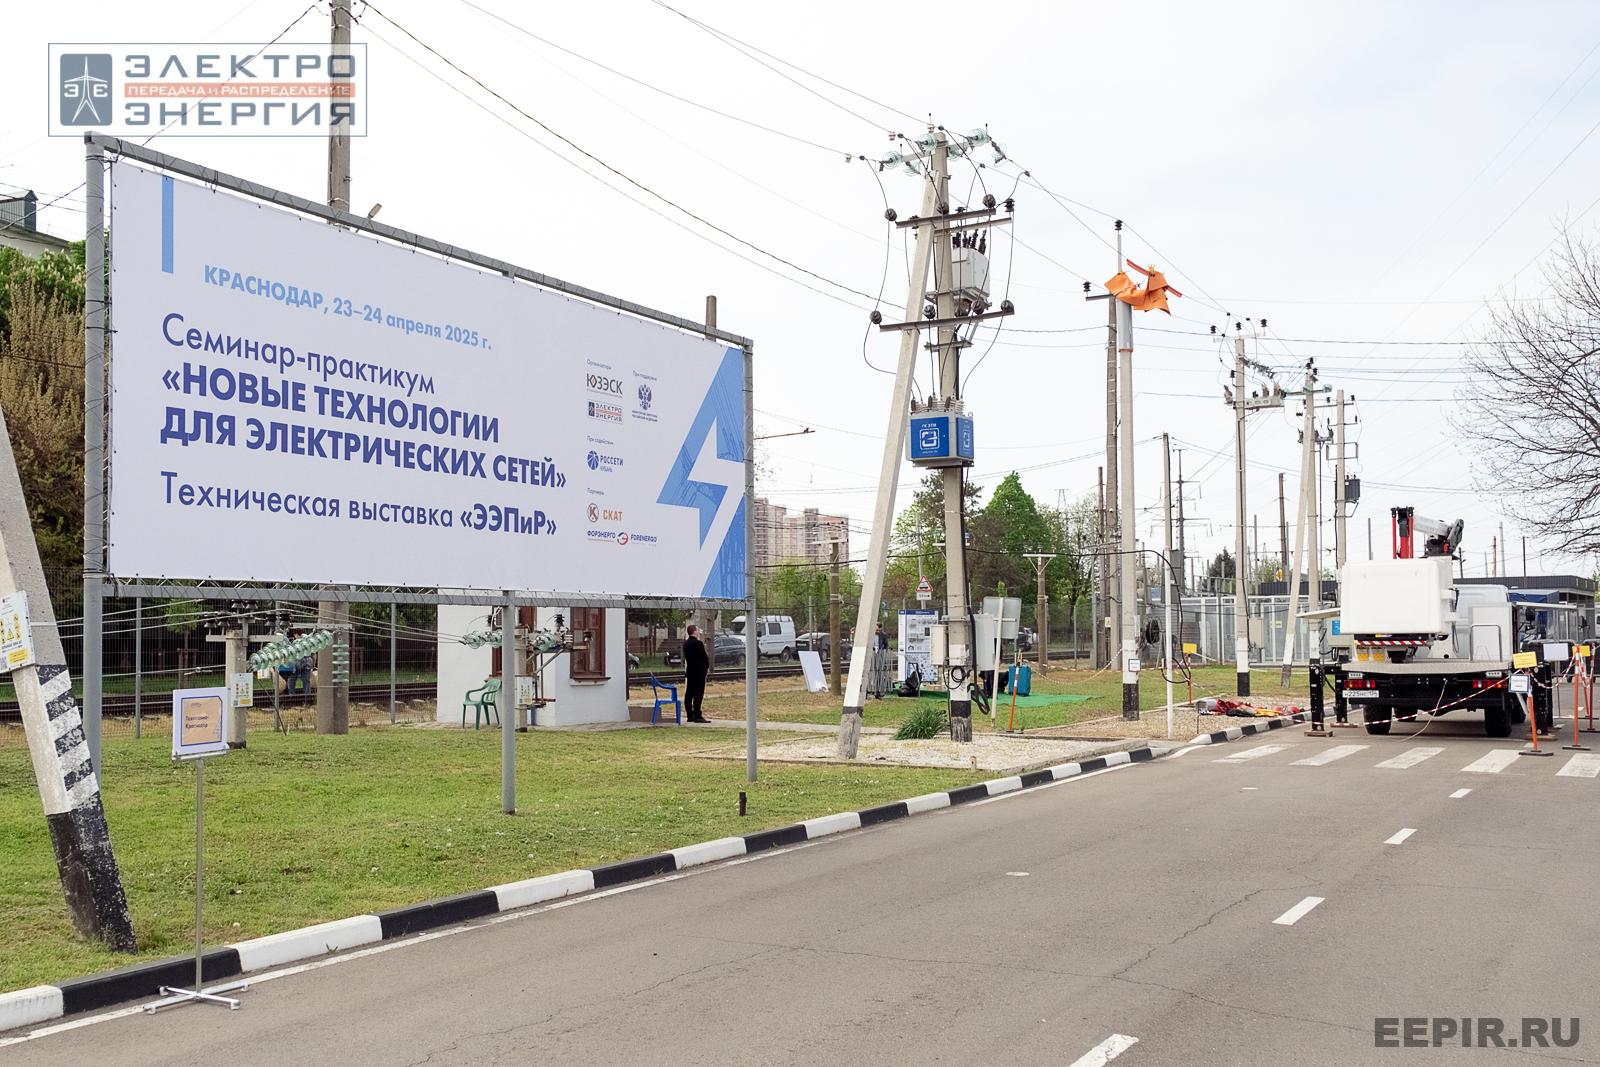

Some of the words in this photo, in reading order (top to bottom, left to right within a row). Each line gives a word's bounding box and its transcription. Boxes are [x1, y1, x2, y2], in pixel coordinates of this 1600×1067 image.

[204, 264, 329, 315] КРАСНОДАР,
[385, 314, 442, 342] апреля
[444, 324, 479, 347] 2025
[482, 337, 493, 350] г.
[162, 312, 436, 398] Семинар-практикум
[586, 372, 623, 395] ЮЗЭСК
[161, 361, 307, 413] «НОВЫЕ
[313, 385, 499, 444] ТЕХНОЛОГИИ
[595, 402, 622, 414] ЭЛЕКТРО
[595, 413, 623, 423] ЭНЕРГИЯ
[159, 405, 236, 448] ДЛЯ
[245, 417, 488, 479] ЭЛЕКТРИЧЕСКИХ
[492, 454, 567, 490] СЕТЕЙ»
[600, 455, 624, 467] РОССЕТИ
[160, 470, 340, 518] Техническая
[348, 499, 453, 528] выставка
[459, 506, 557, 536] «ЭЭПиР»
[603, 509, 623, 521] СКАТ
[586, 530, 616, 539] ФОРЭНЕРГО
[630, 534, 658, 543] FORENERGO
